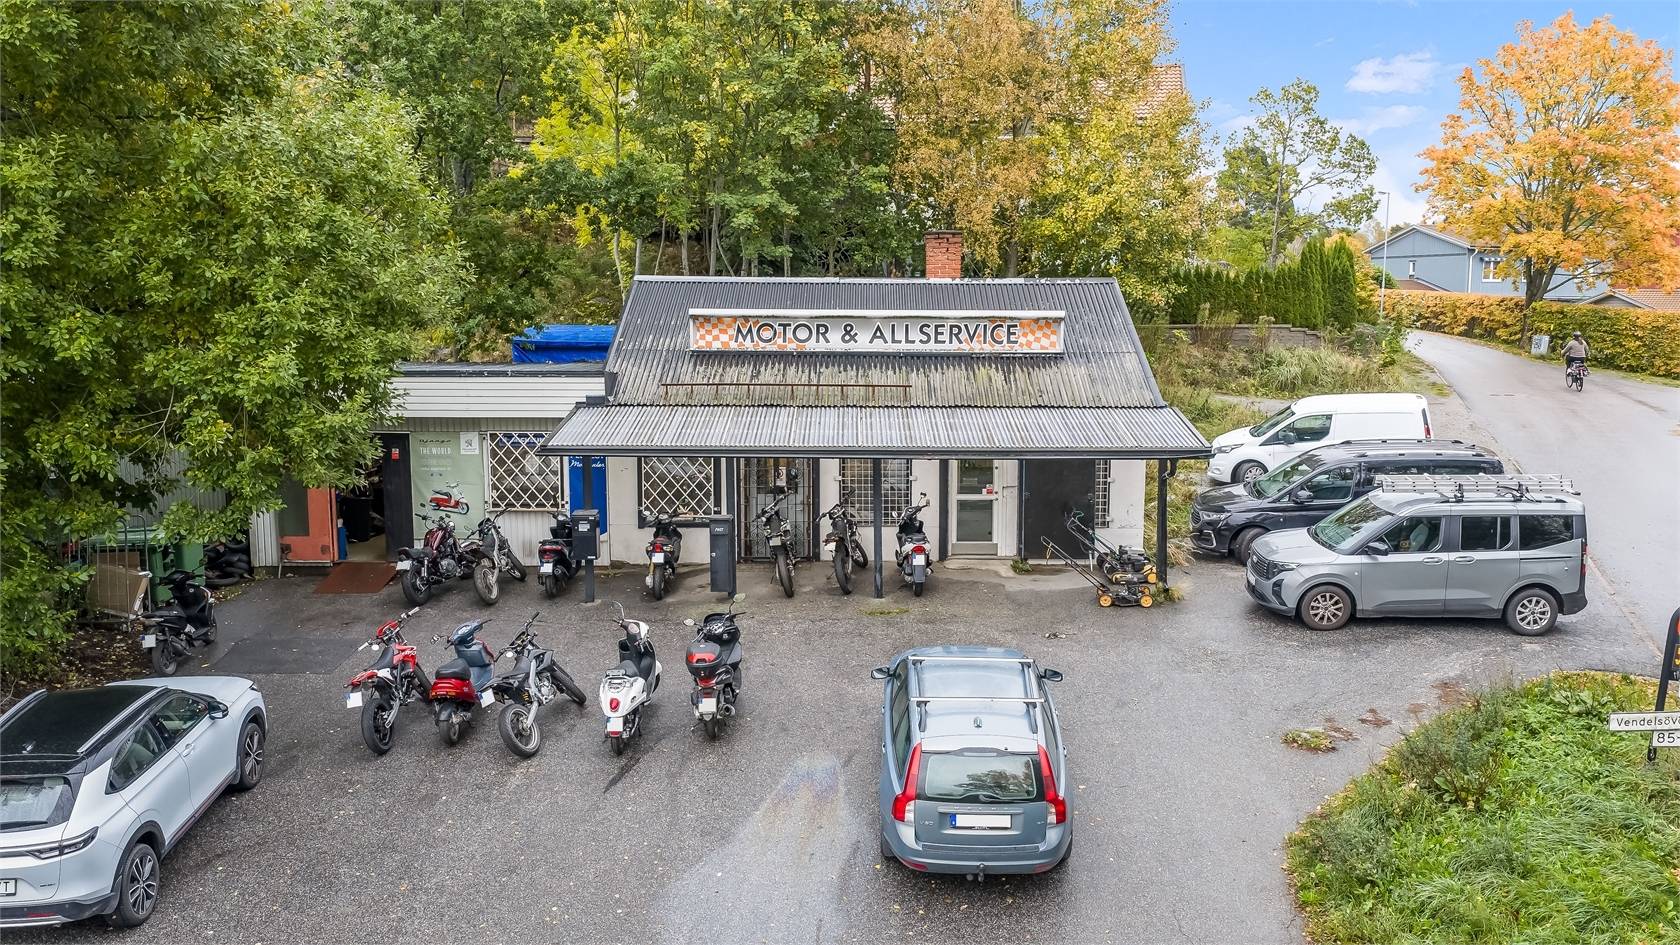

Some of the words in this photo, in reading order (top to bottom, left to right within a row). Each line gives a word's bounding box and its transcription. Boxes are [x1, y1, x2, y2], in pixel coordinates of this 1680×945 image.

[734, 322, 831, 345] MOTOR
[842, 323, 859, 344] &
[868, 322, 1020, 346] ALLSERVICE
